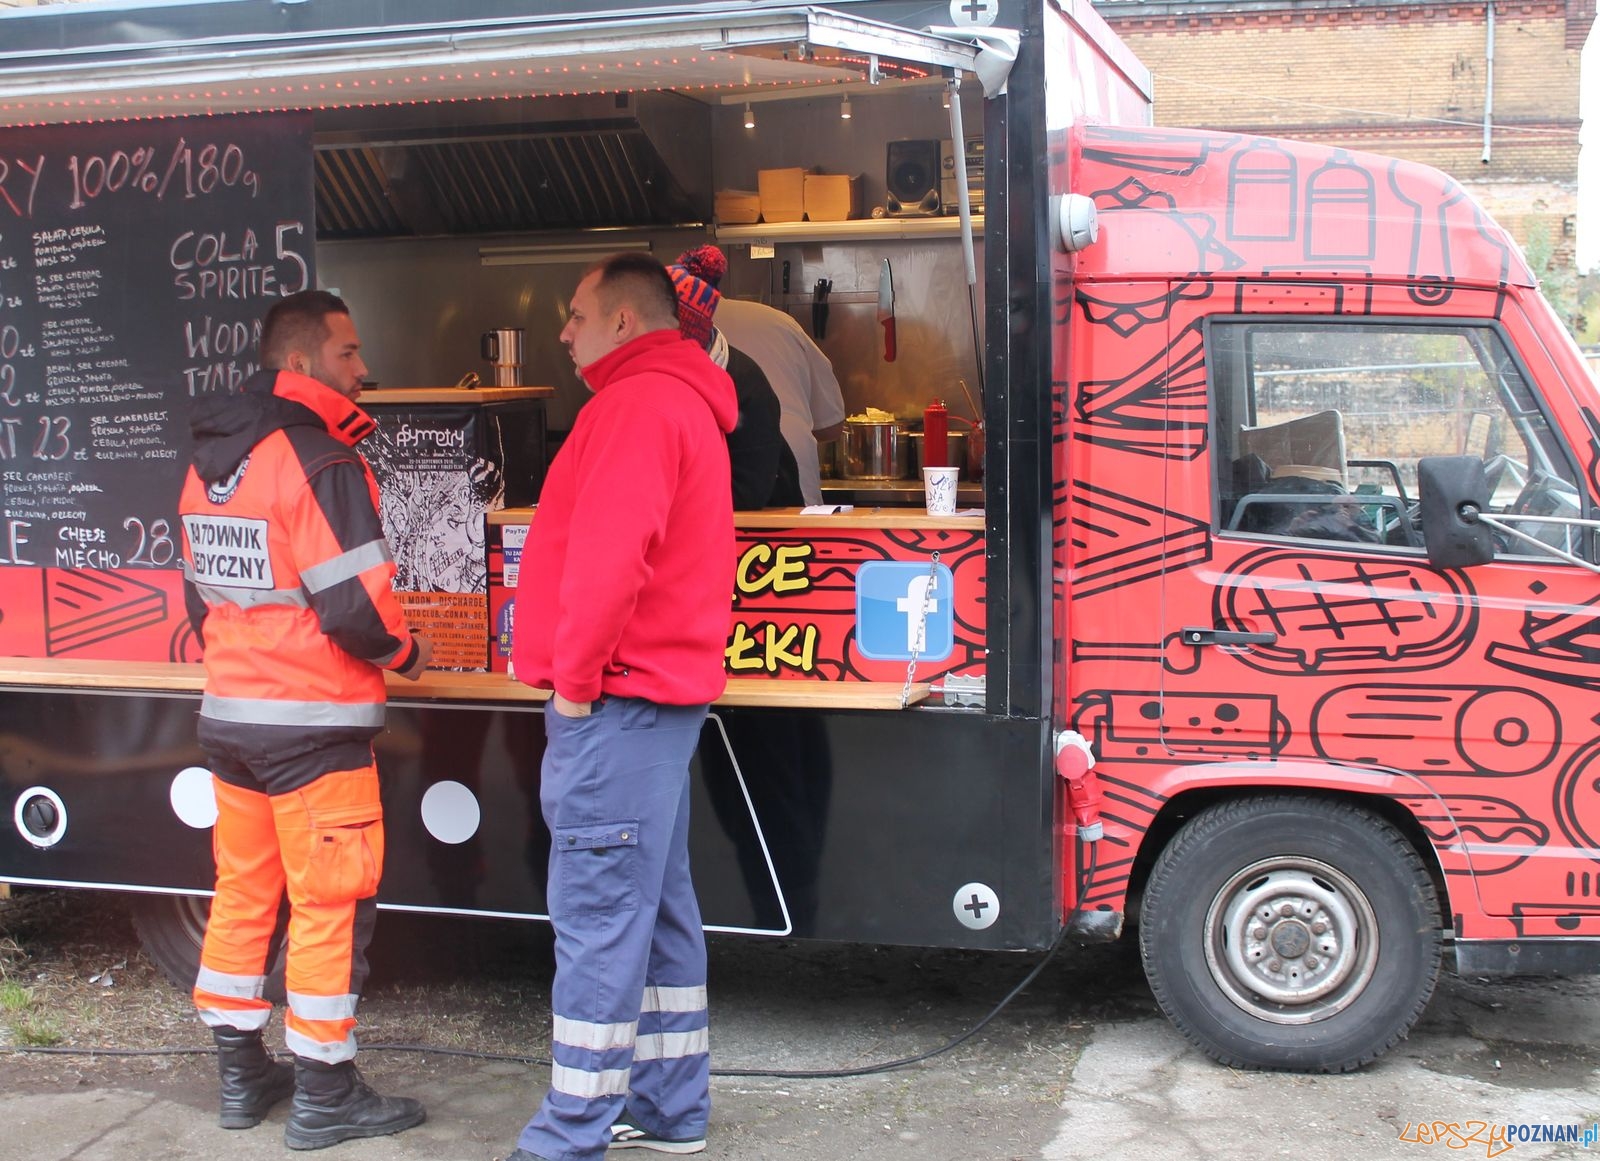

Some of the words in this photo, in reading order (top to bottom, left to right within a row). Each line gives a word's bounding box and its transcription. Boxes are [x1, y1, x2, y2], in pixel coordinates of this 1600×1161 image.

[171, 228, 258, 270] COLA
[276, 221, 309, 297] 5
[175, 265, 277, 299] SPIRITE
[32, 416, 71, 460] 23
[58, 526, 106, 543] CHEESE
[124, 517, 174, 567] 28
[736, 544, 812, 593] CE
[408, 596, 431, 604] MOON
[440, 597, 484, 607] DISCHARGE
[724, 623, 817, 671] ŁKI
